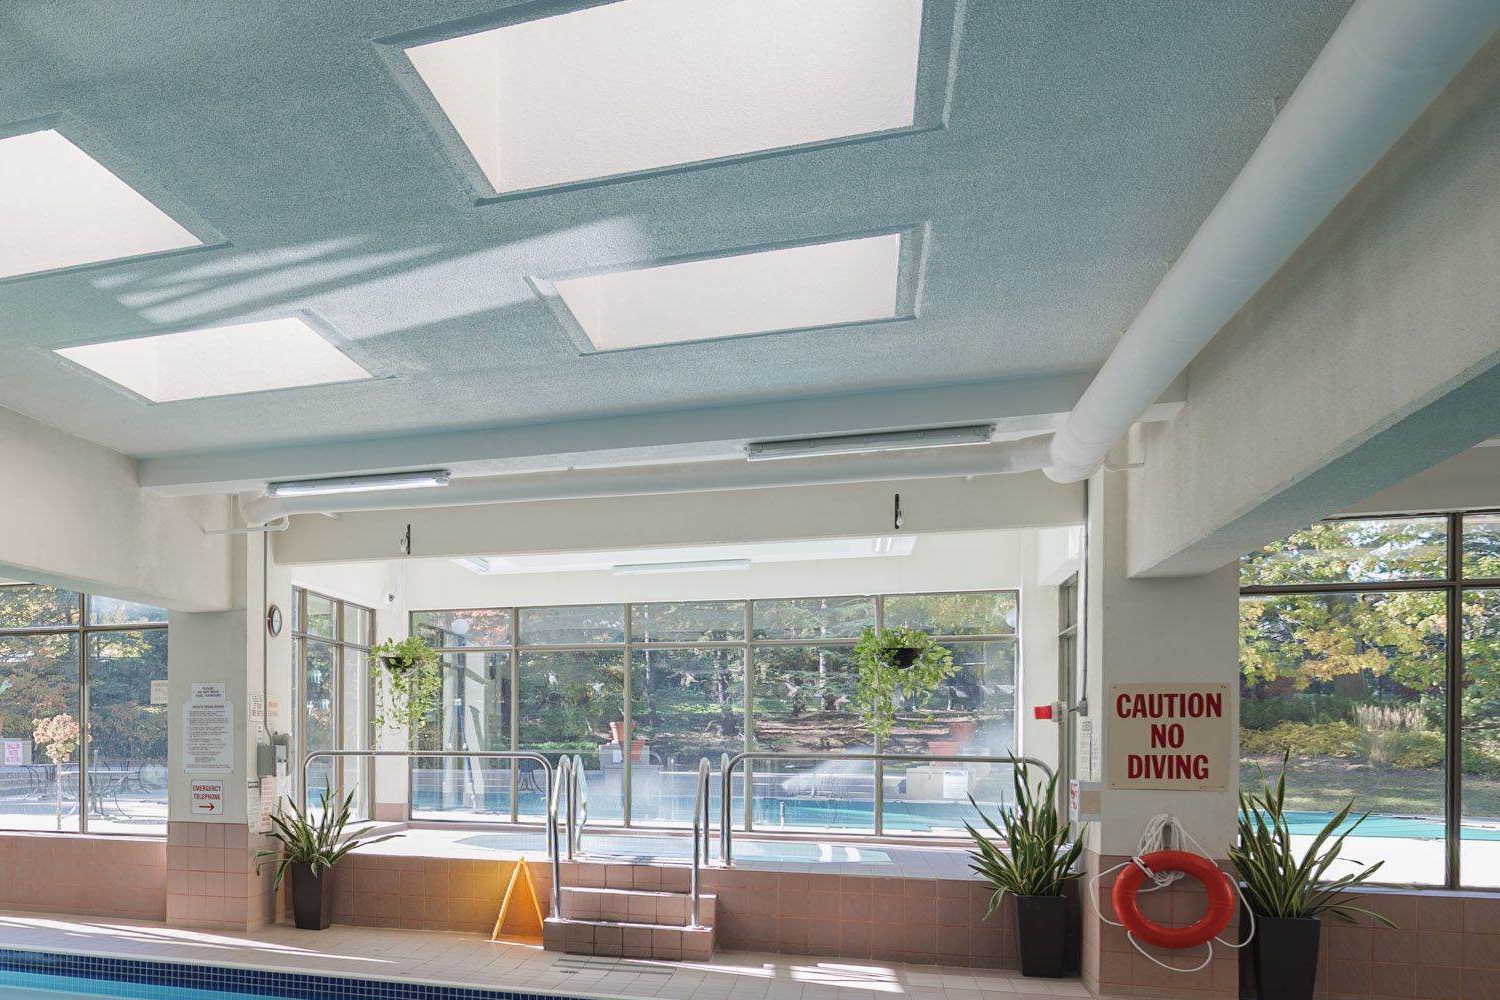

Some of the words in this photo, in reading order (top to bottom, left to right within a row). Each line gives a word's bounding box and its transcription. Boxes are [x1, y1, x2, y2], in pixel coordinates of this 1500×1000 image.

[1116, 692, 1222, 718] CAUTION
[1150, 723, 1184, 749] NO
[1127, 754, 1209, 780] DIVING
